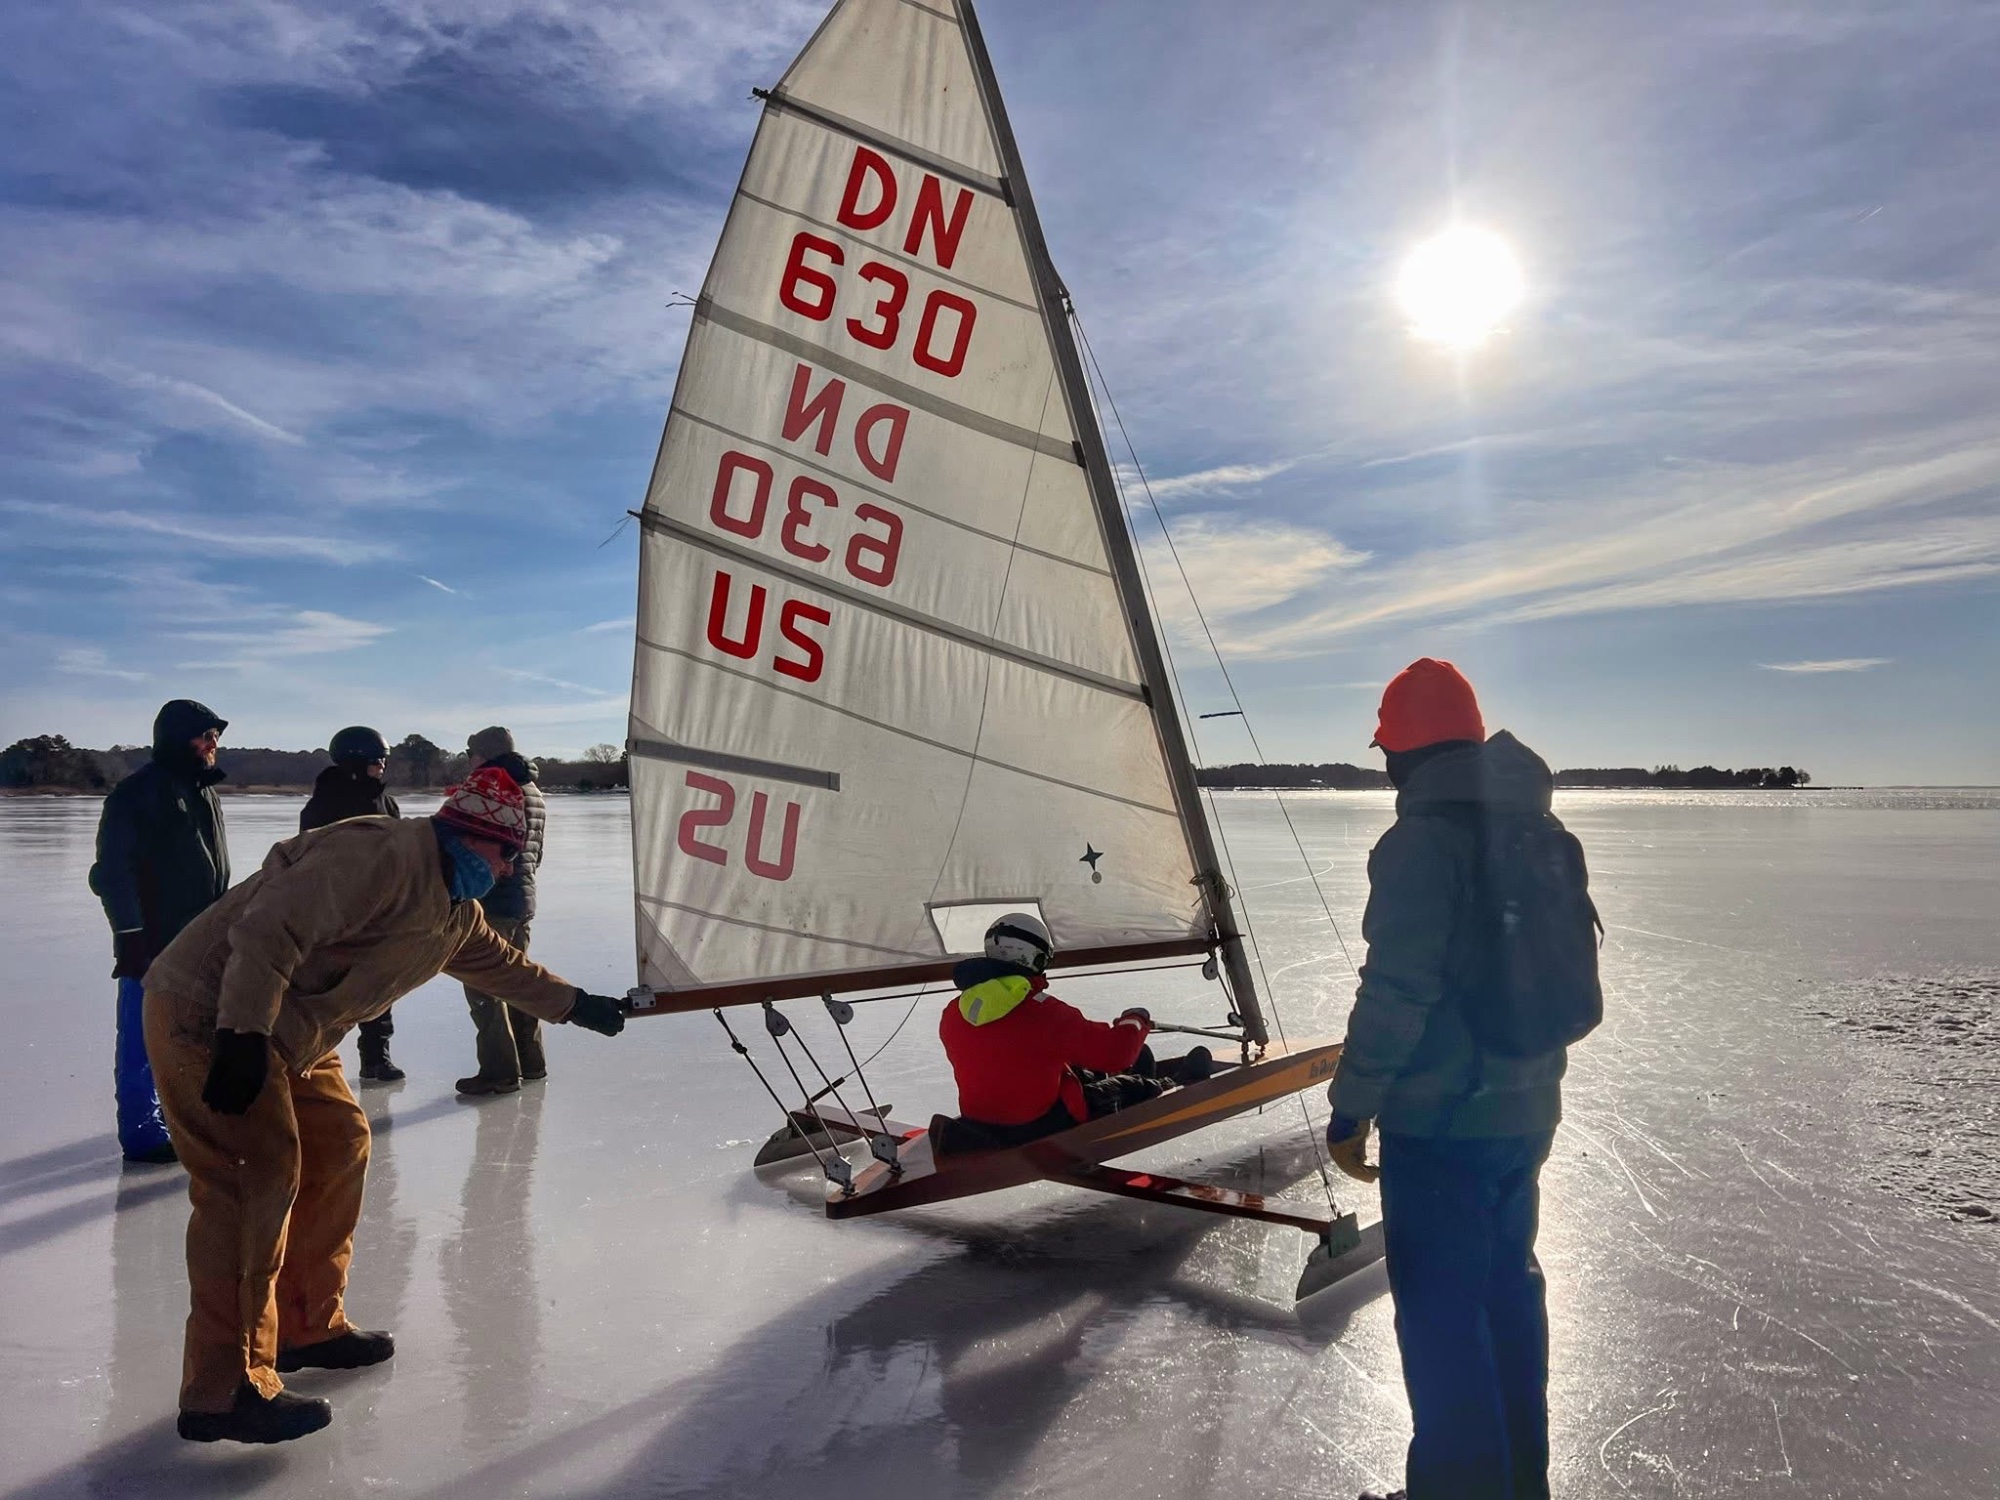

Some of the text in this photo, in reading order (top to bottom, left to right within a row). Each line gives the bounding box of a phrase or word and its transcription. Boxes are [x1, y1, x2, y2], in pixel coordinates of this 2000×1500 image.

[836, 145, 975, 269] DN
[778, 231, 977, 378] 630
[706, 570, 831, 683] US
